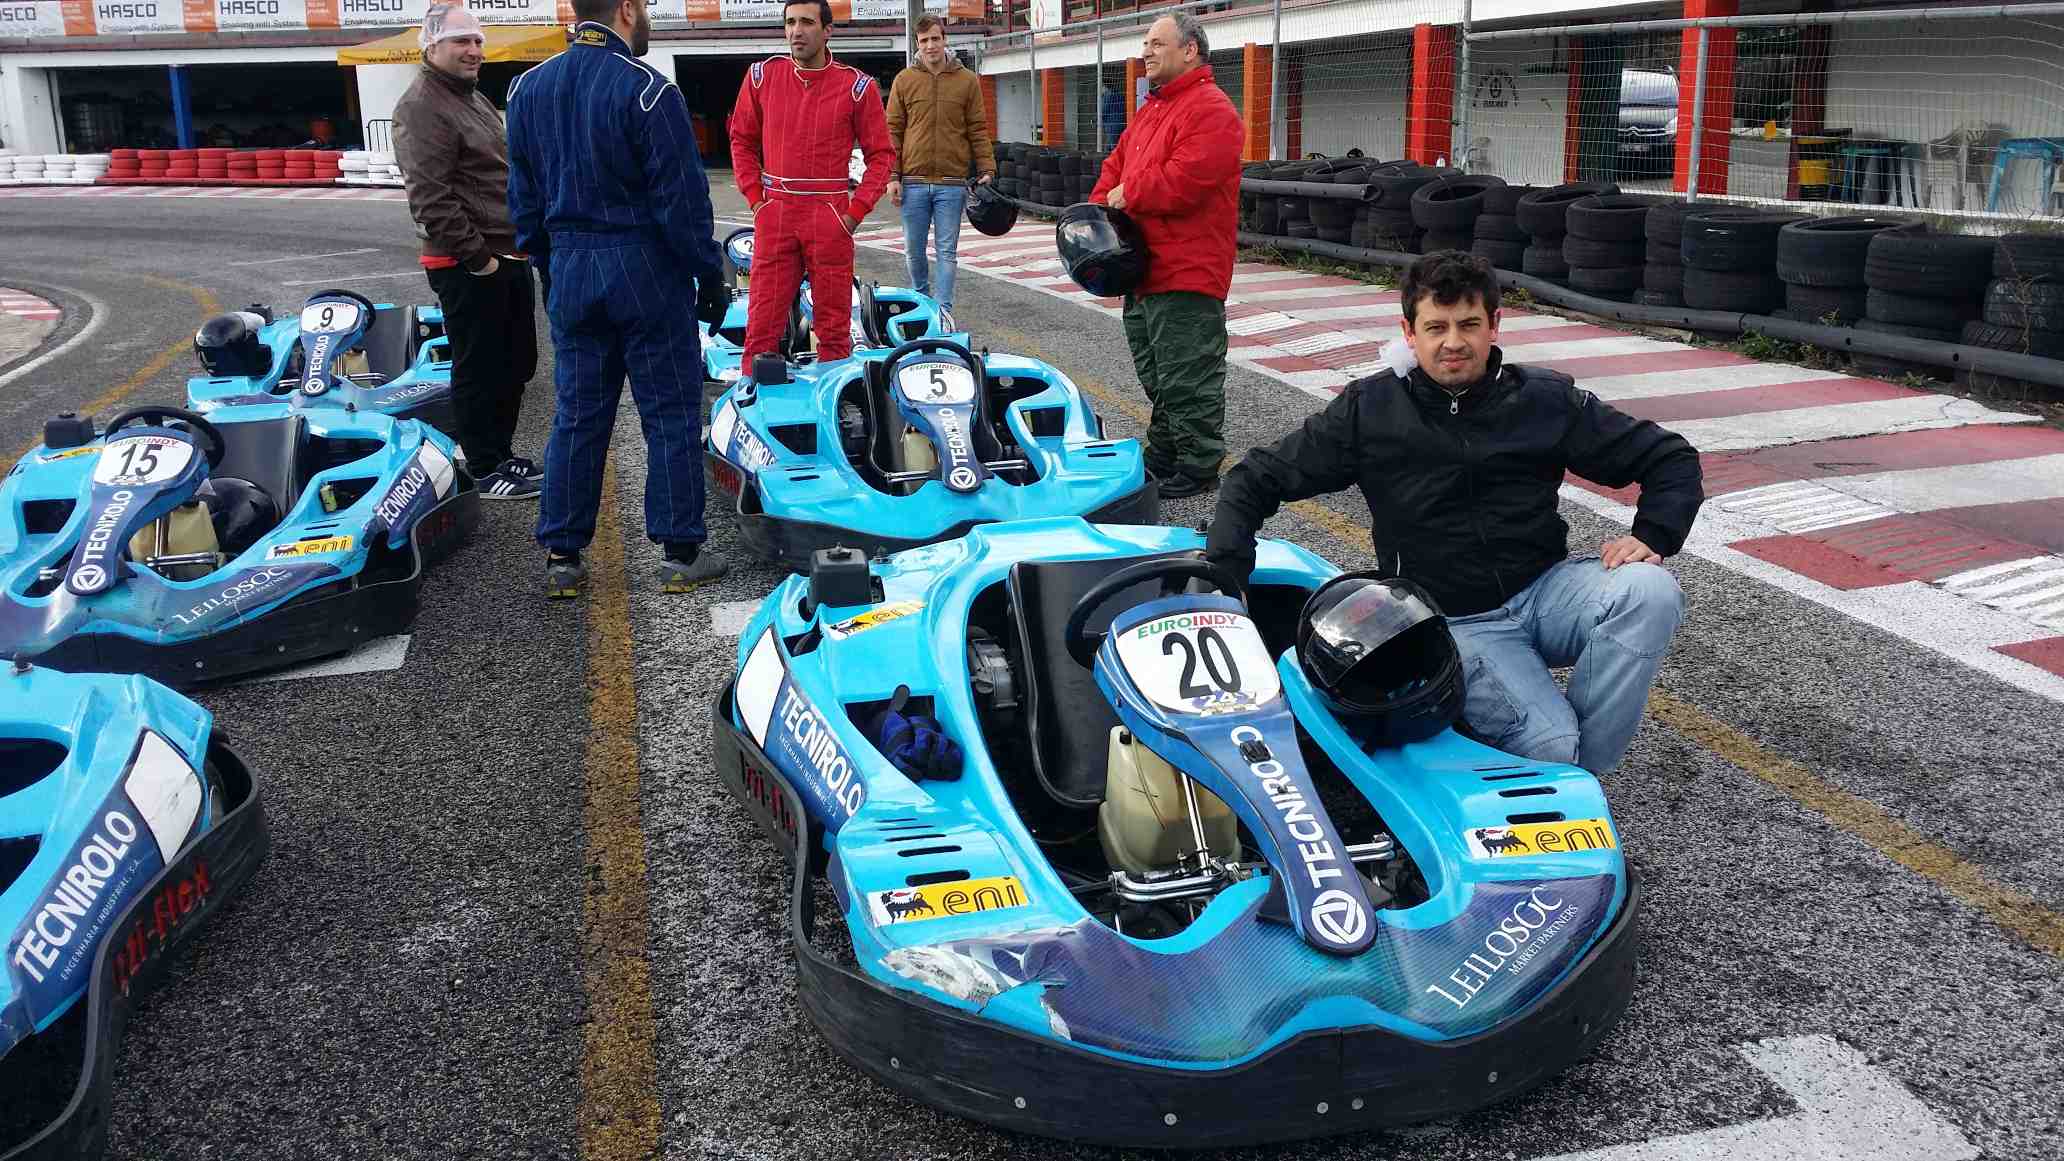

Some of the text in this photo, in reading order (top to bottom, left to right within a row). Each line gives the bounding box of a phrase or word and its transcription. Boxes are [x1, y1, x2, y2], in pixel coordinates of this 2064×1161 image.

[0, 7, 37, 21] SCO
[99, 4, 157, 18] HASCO
[220, 1, 279, 15] HASCO
[320, 306, 334, 328] 9
[930, 368, 948, 398] 5
[119, 443, 163, 477] 15
[81, 490, 134, 564] TECNIROLO
[171, 565, 288, 626] LEILOSOC
[1137, 614, 1238, 640] EUROINDY
[1162, 626, 1242, 700] 20
[780, 685, 862, 817] TECNIROLO
[1230, 725, 1343, 889] TECNIROO
[1535, 819, 1613, 854] eni
[15, 811, 137, 984] TECNIROLO
[943, 876, 1022, 916] eni
[61, 924, 100, 981] ENGENHARIA
[1425, 883, 1563, 1010] LEILOSOC
[1508, 903, 1580, 976] MARKET PARTNERS
